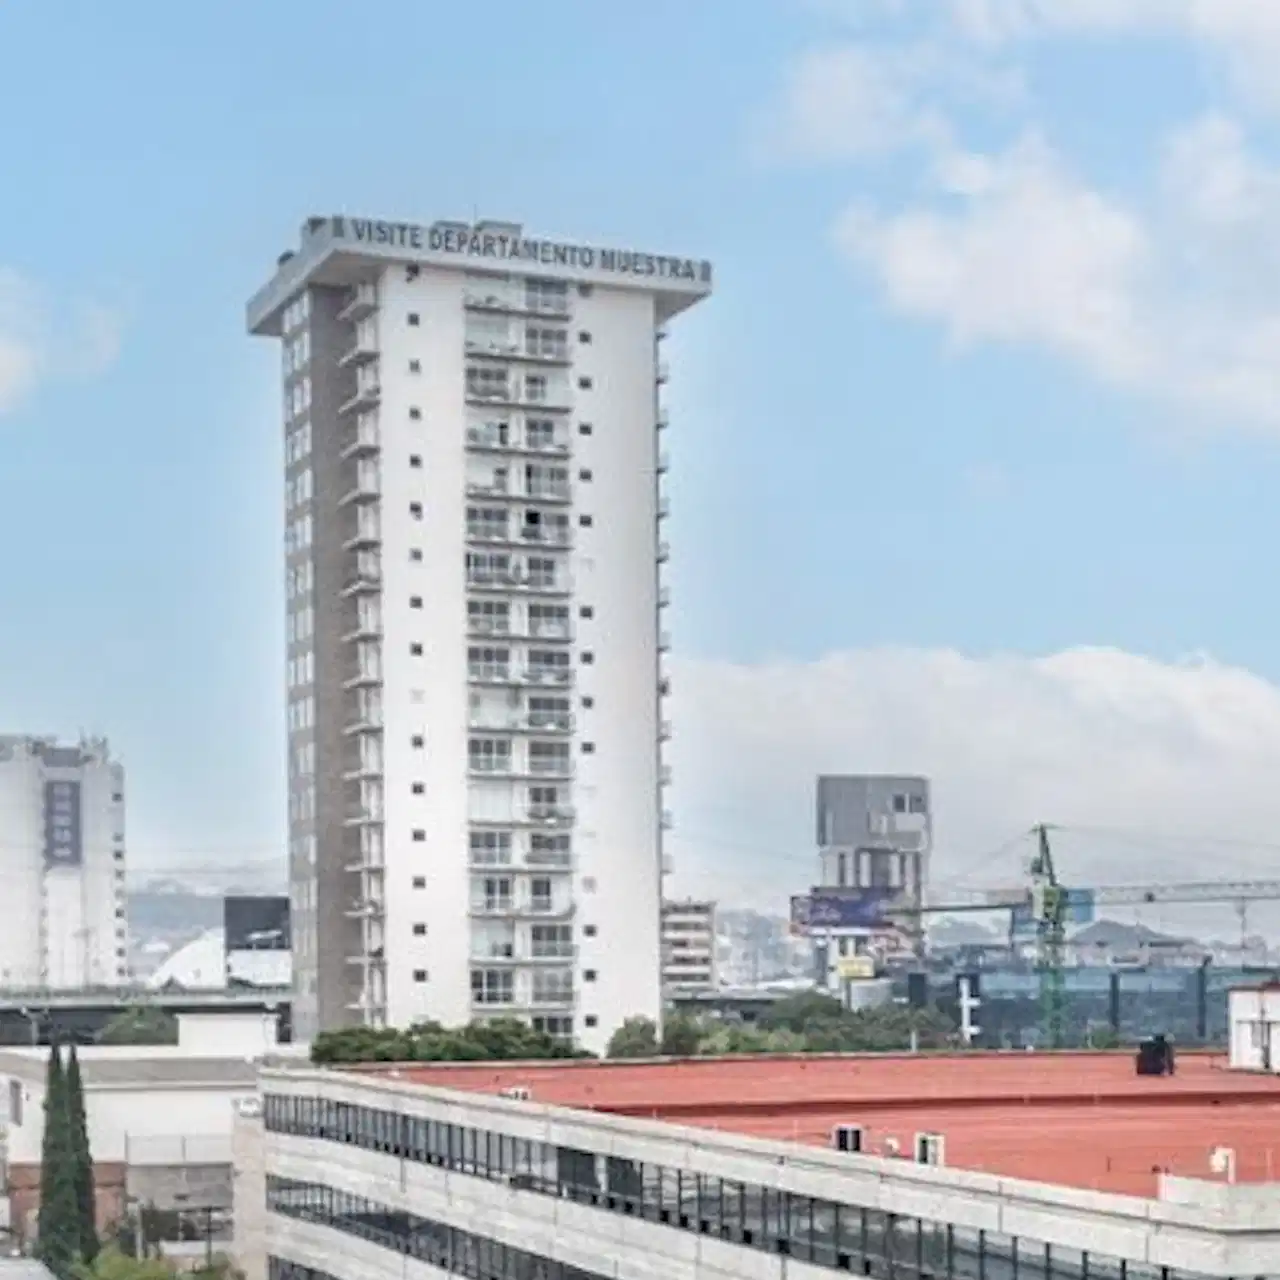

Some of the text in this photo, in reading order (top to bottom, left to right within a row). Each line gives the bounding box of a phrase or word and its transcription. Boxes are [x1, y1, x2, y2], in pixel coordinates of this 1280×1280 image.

[350, 217, 696, 281] VISITE DEPARTAMENTO MUESTRA
